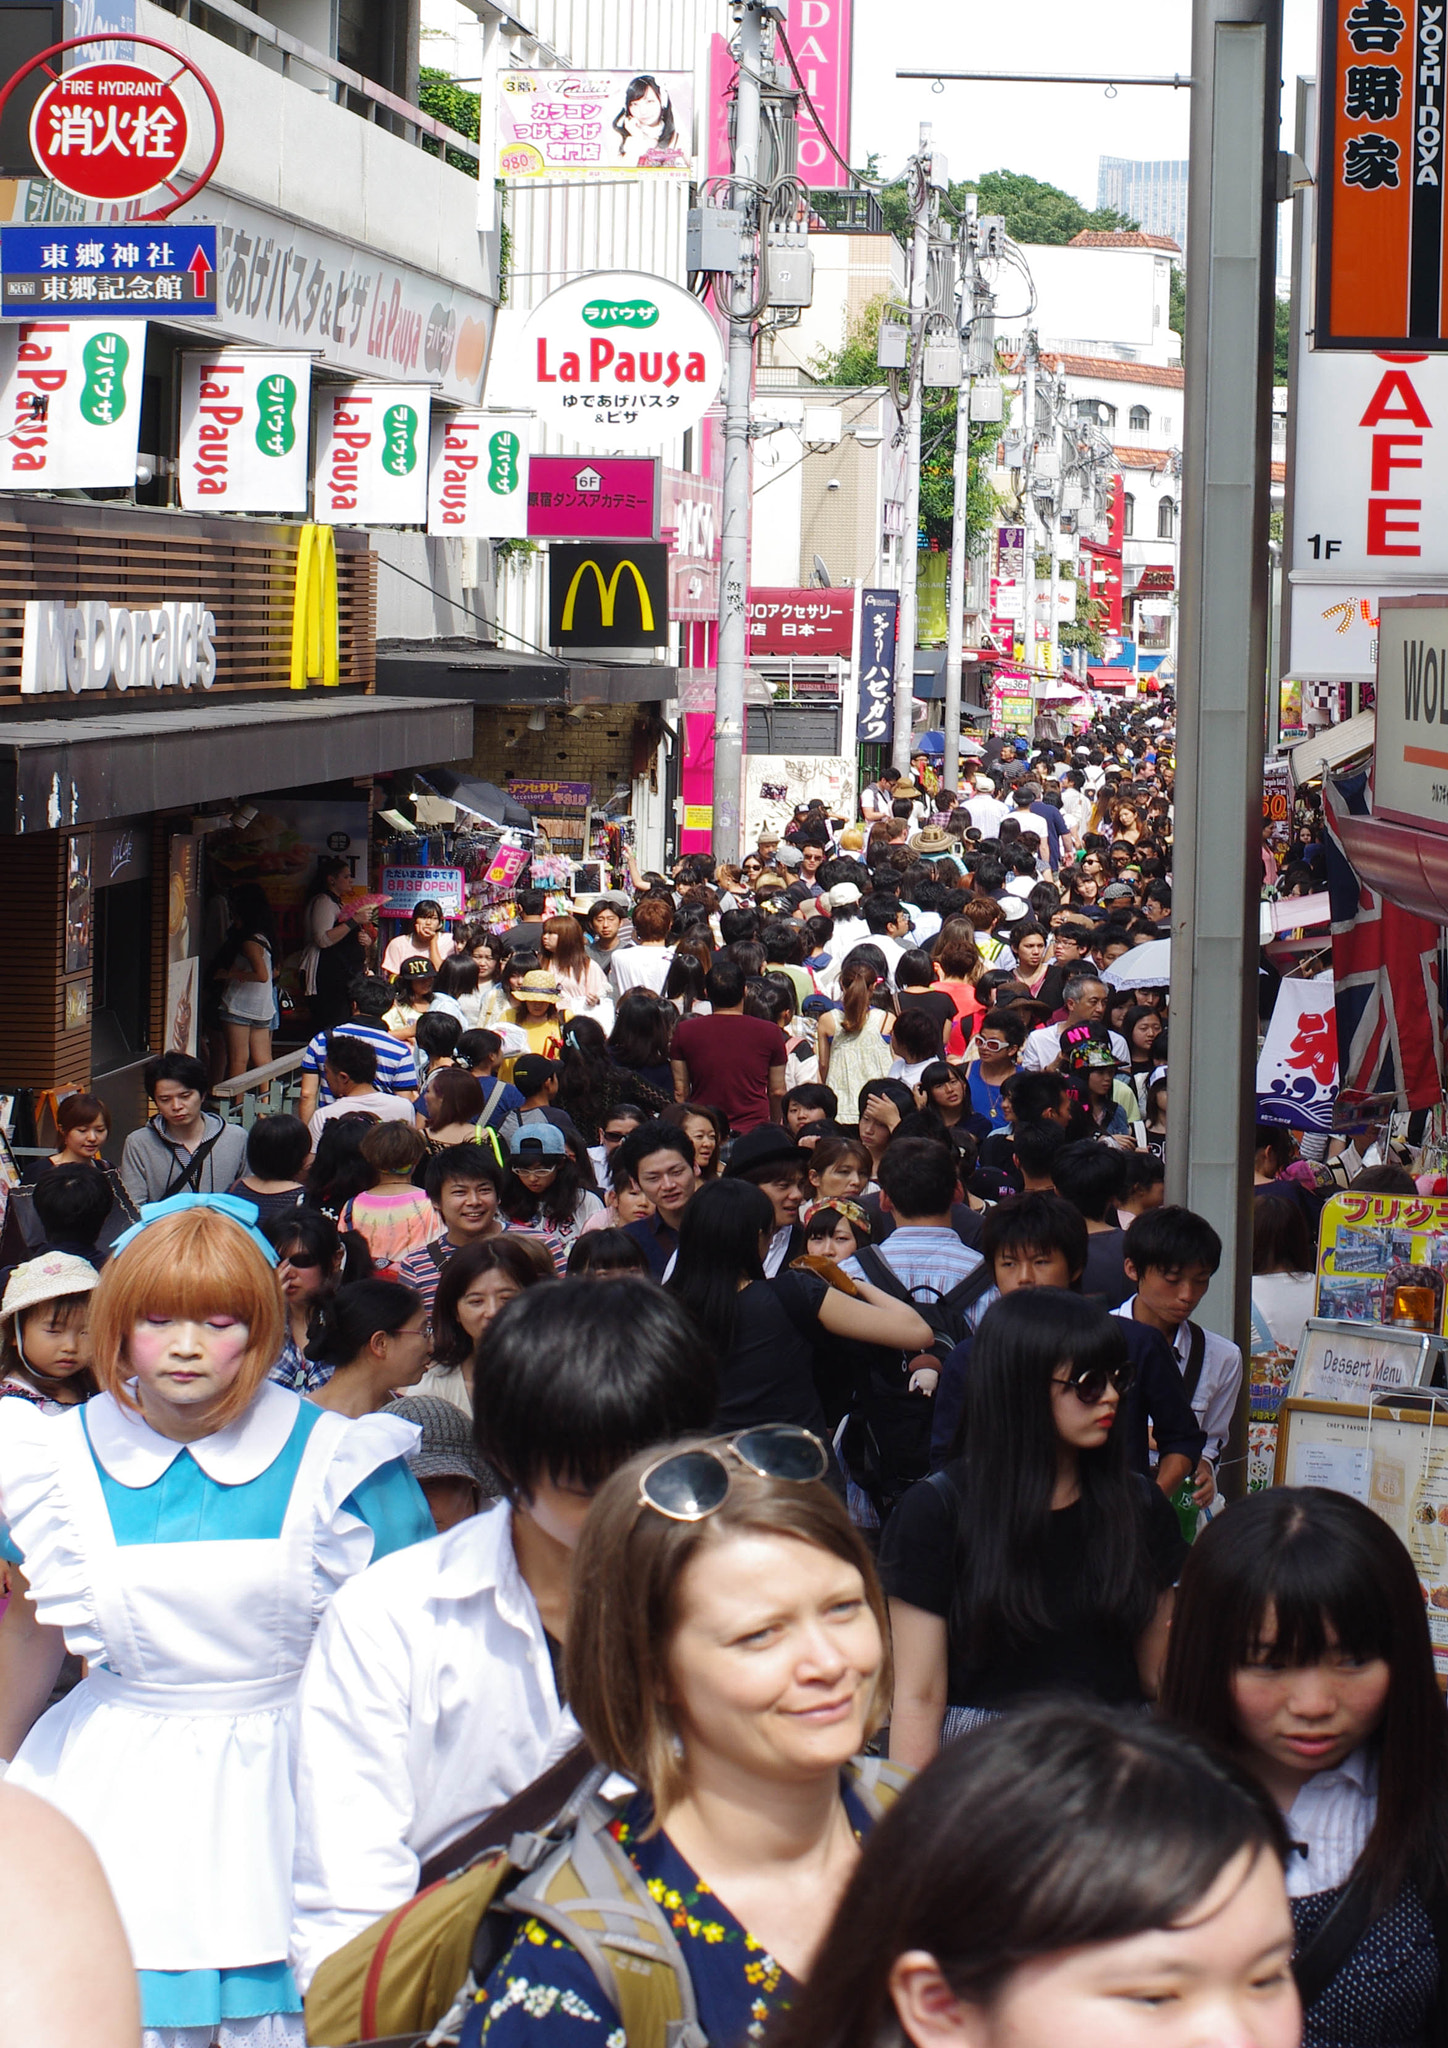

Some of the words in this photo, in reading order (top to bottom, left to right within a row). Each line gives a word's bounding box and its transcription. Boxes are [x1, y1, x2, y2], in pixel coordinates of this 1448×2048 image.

[62, 80, 94, 96] FIRE
[98, 80, 164, 97] HYDRANT
[795, 1, 830, 167] DAISO
[1416, 5, 1443, 186] YOSHINOYA
[531, 102, 602, 120] カラコン
[48, 104, 178, 159] 消火栓
[513, 122, 602, 140] つけまつげ
[502, 153, 529, 170] 980
[40, 242, 176, 269] 東郷神社
[40, 274, 183, 301] 東郷記念館
[584, 306, 657, 321] ラパウザ
[92, 335, 117, 424] ラパウザ
[563, 394, 680, 408] ゆであげパスタ
[266, 377, 285, 455] ラパウザ
[595, 411, 638, 424] &ピザ
[391, 406, 408, 475] ラパウザ
[1357, 350, 1433, 556] AFE
[495, 432, 511, 495] ラパウザ
[579, 476, 598, 488] 6F
[1307, 533, 1342, 560] 1F
[781, 622, 833, 637] 日本一
[872, 612, 890, 663] ギャラリー
[860, 665, 891, 741] ハセガワ
[509, 783, 569, 794] アクセサリー
[409, 960, 428, 974] NY
[1067, 1026, 1090, 1044] NY
[1323, 1349, 1371, 1378] Dessert
[1373, 1358, 1402, 1384] Menu
